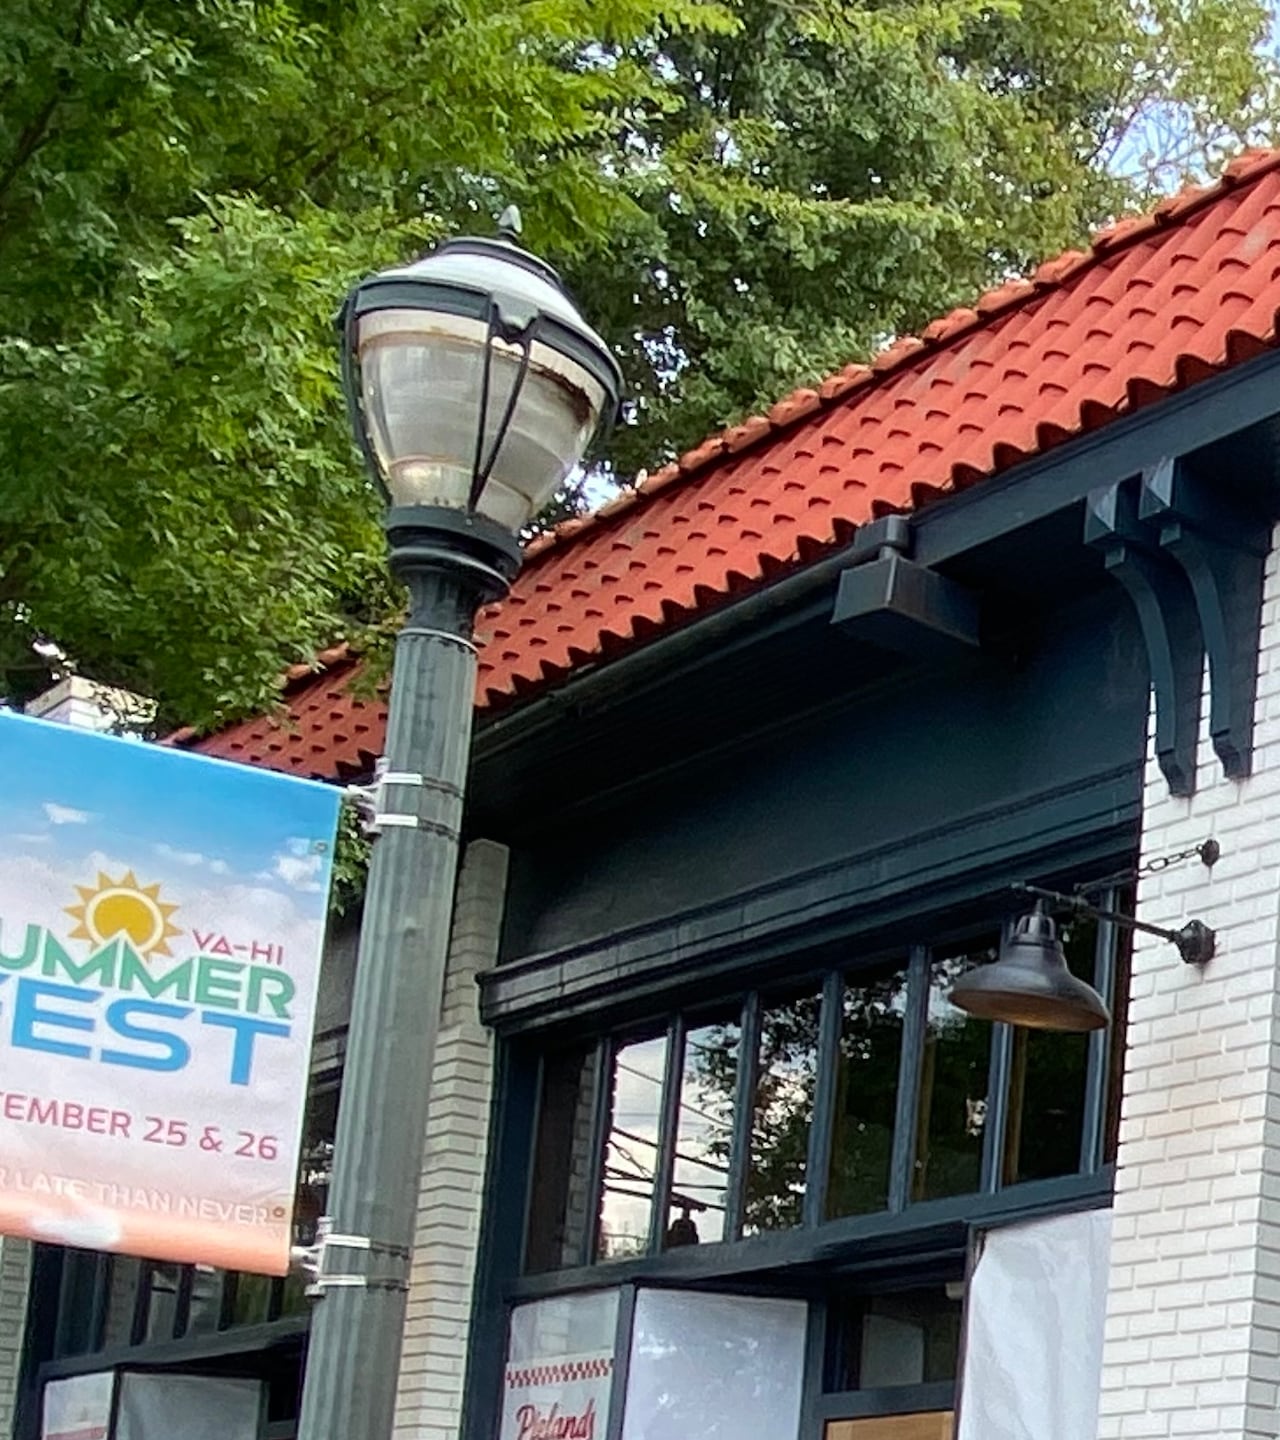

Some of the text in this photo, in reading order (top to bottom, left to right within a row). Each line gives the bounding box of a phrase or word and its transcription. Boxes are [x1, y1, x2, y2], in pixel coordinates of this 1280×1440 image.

[0, 923, 296, 1020] UMMER
[192, 928, 284, 966] VA-HI
[0, 973, 291, 1086] EST
[0, 1091, 279, 1160] EMBER 25 & 26
[15, 1169, 83, 1200] LATE
[92, 1183, 171, 1213] THAN
[179, 1197, 269, 1225] NEVER
